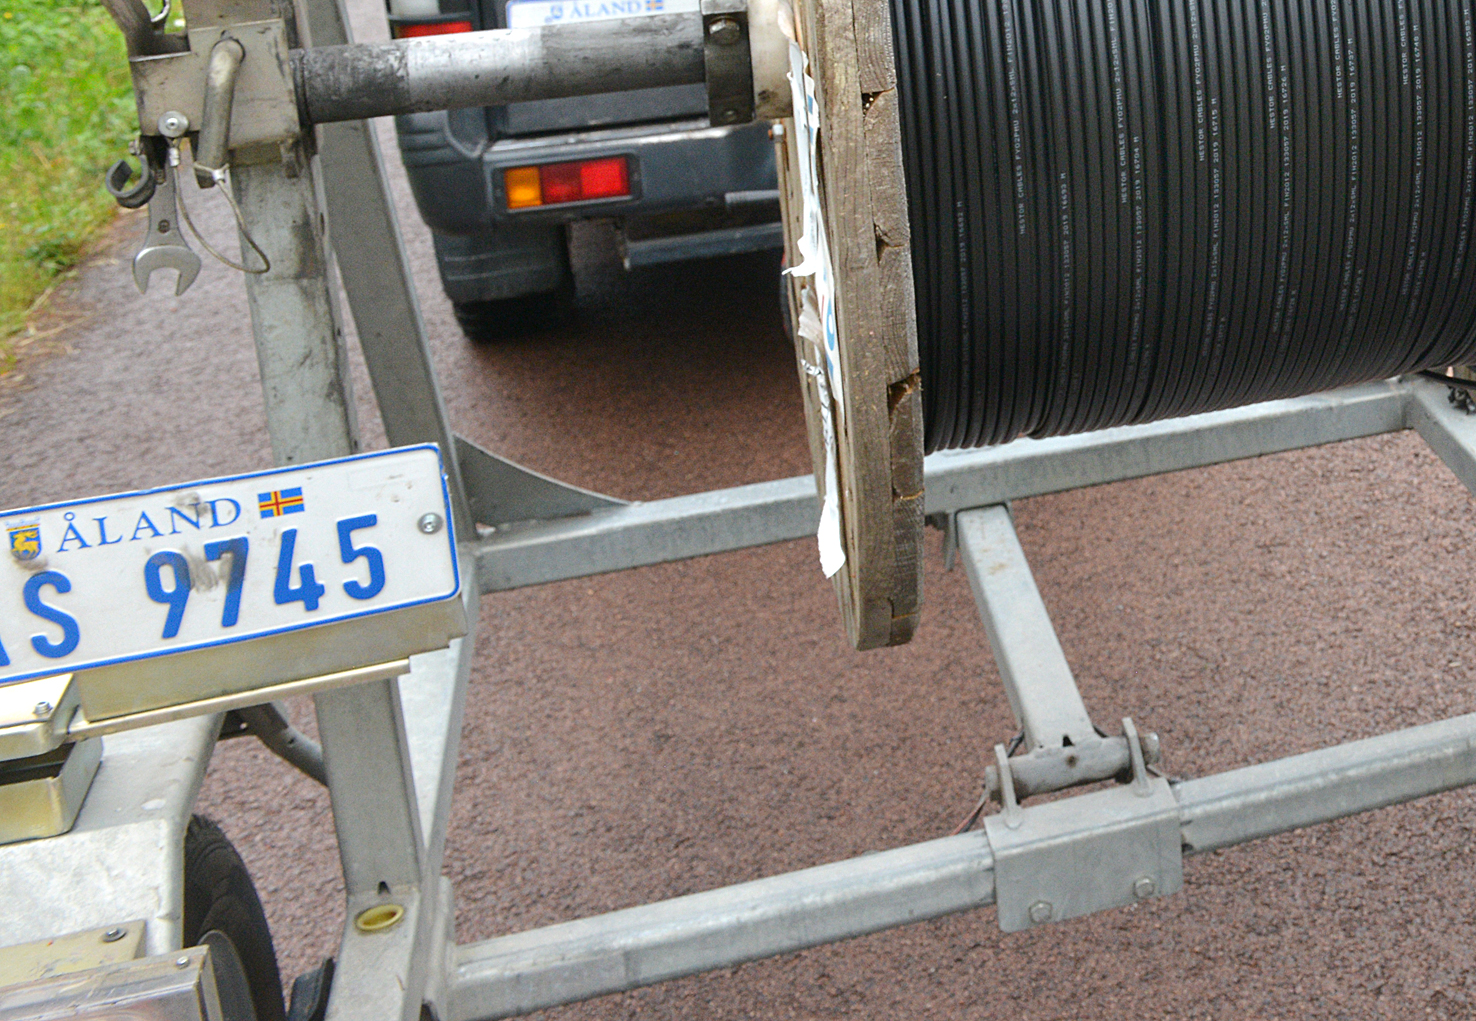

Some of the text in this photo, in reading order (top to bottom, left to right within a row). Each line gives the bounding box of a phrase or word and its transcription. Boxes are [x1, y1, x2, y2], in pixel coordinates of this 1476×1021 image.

[570, 0, 641, 19] ÅLAND
[56, 496, 242, 553] ÅLAND
[0, 513, 386, 667] S 9745
